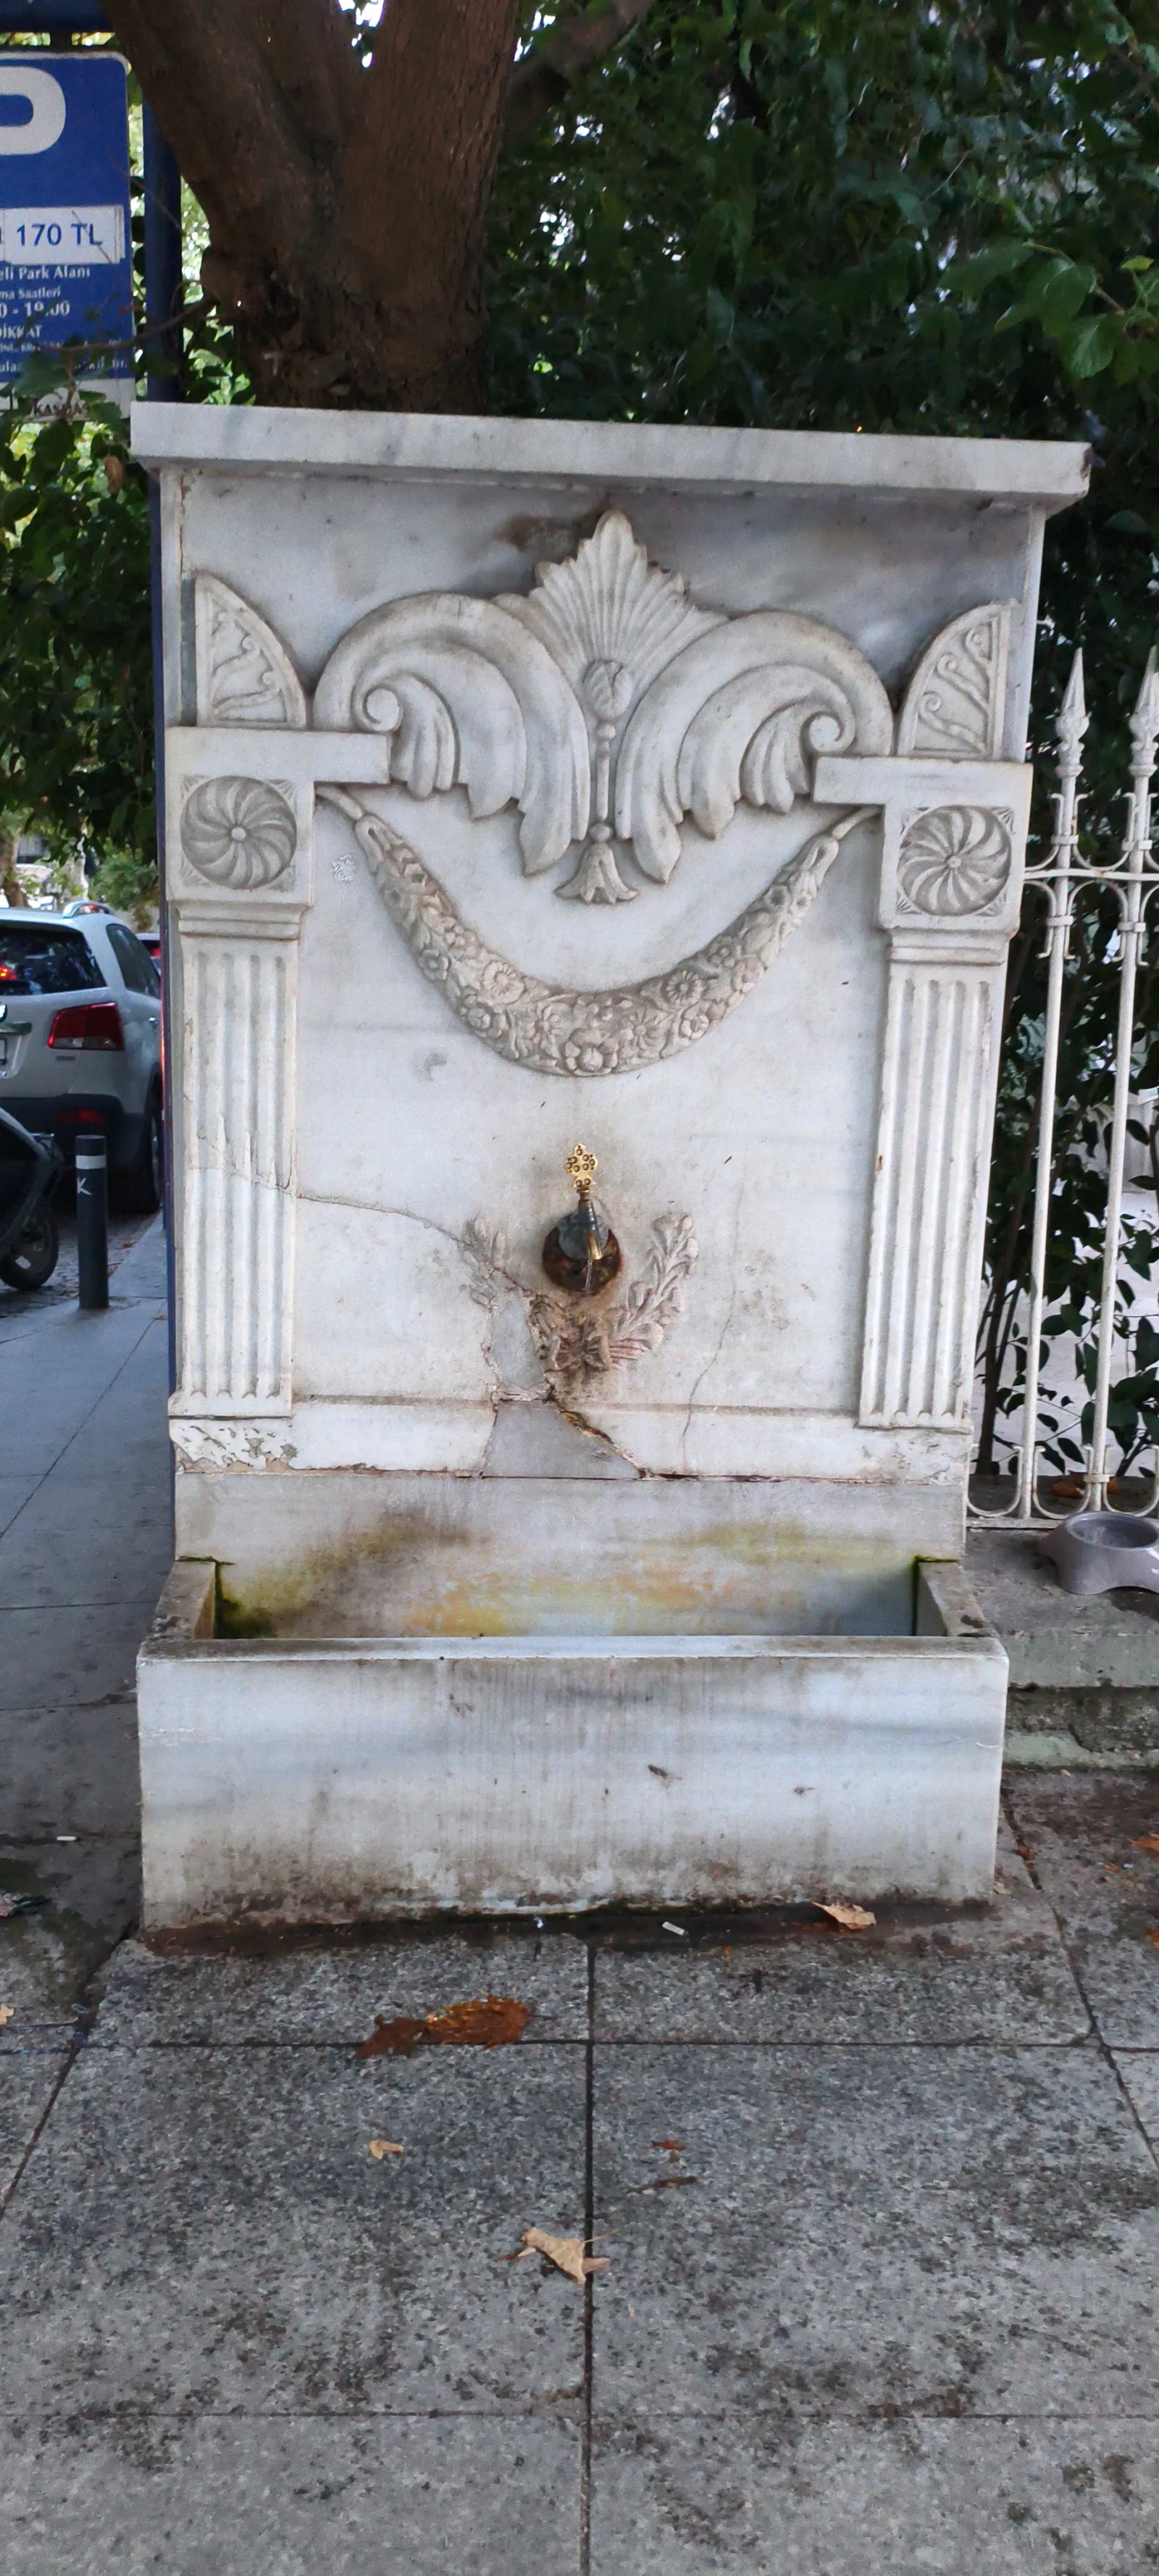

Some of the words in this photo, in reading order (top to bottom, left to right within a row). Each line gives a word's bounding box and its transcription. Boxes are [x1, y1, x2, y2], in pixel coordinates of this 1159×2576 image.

[17, 222, 62, 247] 170
[70, 222, 104, 246] TL
[19, 265, 50, 280] Park
[54, 264, 91, 279] Alanı
[18, 285, 62, 300] Saatleri
